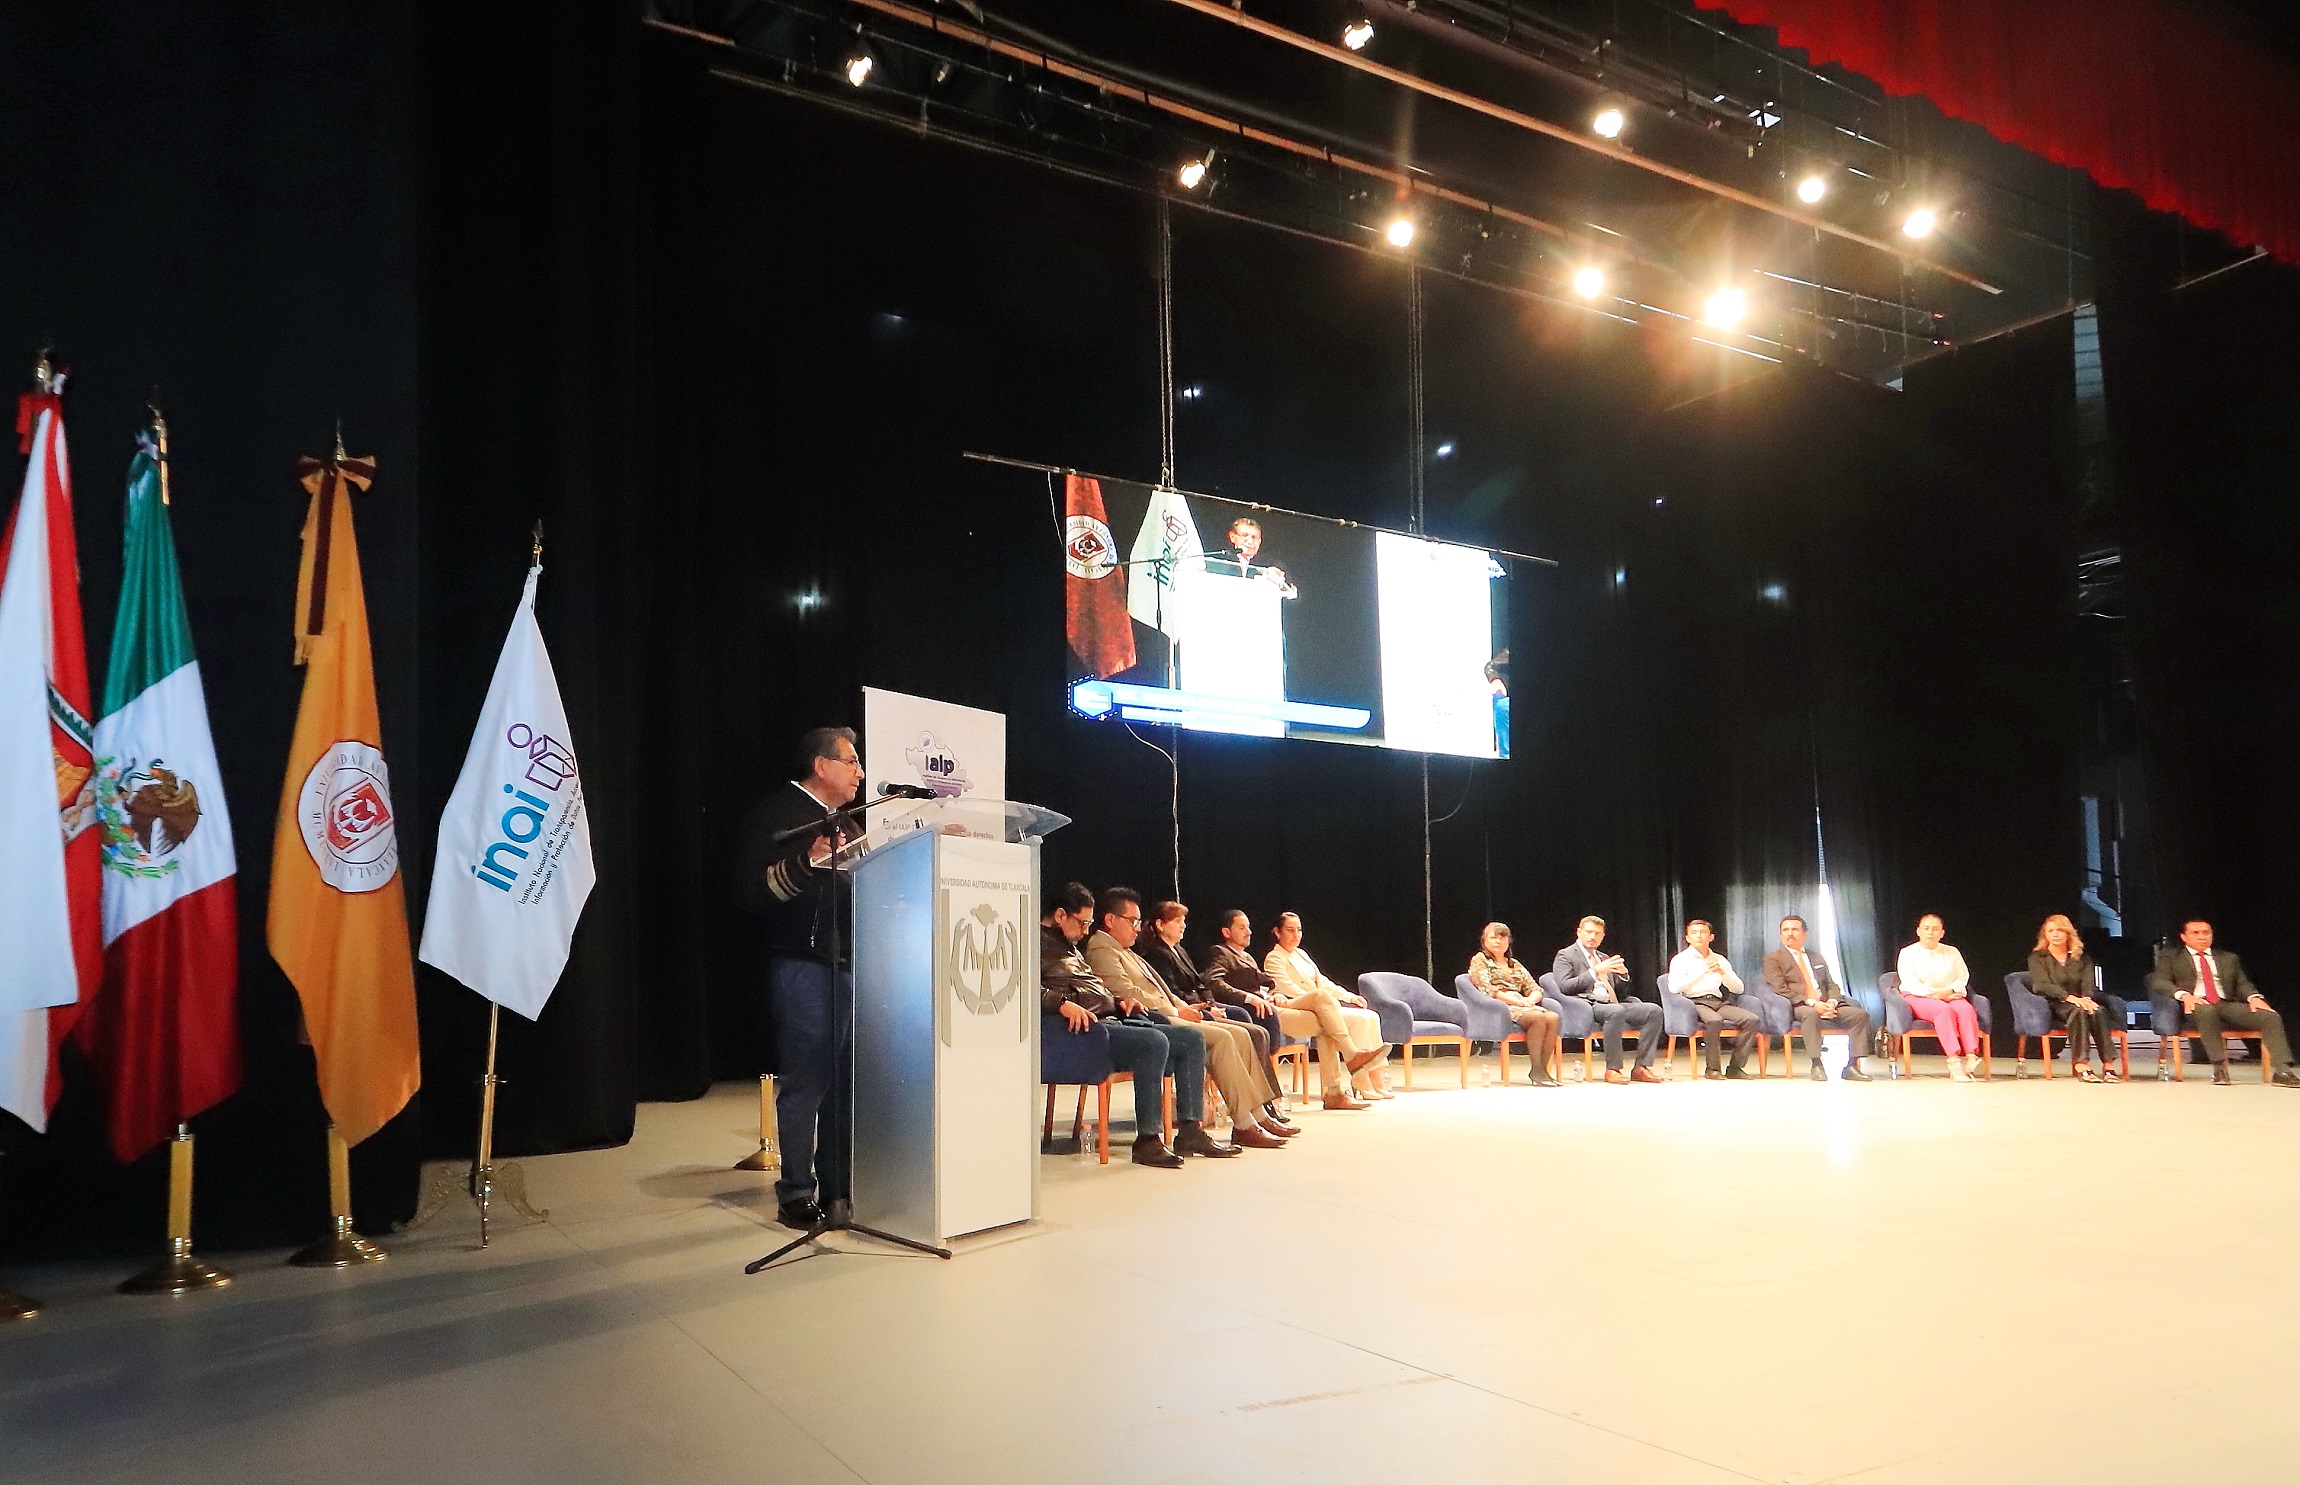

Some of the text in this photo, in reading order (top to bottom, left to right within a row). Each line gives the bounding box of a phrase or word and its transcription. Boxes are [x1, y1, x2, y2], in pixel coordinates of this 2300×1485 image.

[519, 879, 537, 905] Instituto
[533, 850, 549, 877] Nacional
[547, 839, 554, 849] de
[531, 870, 552, 905] Información
[551, 831, 571, 861] Protección
[568, 821, 575, 830] de
[1001, 882, 1008, 890] DE
[1008, 883, 1031, 892] TLAXCALA
